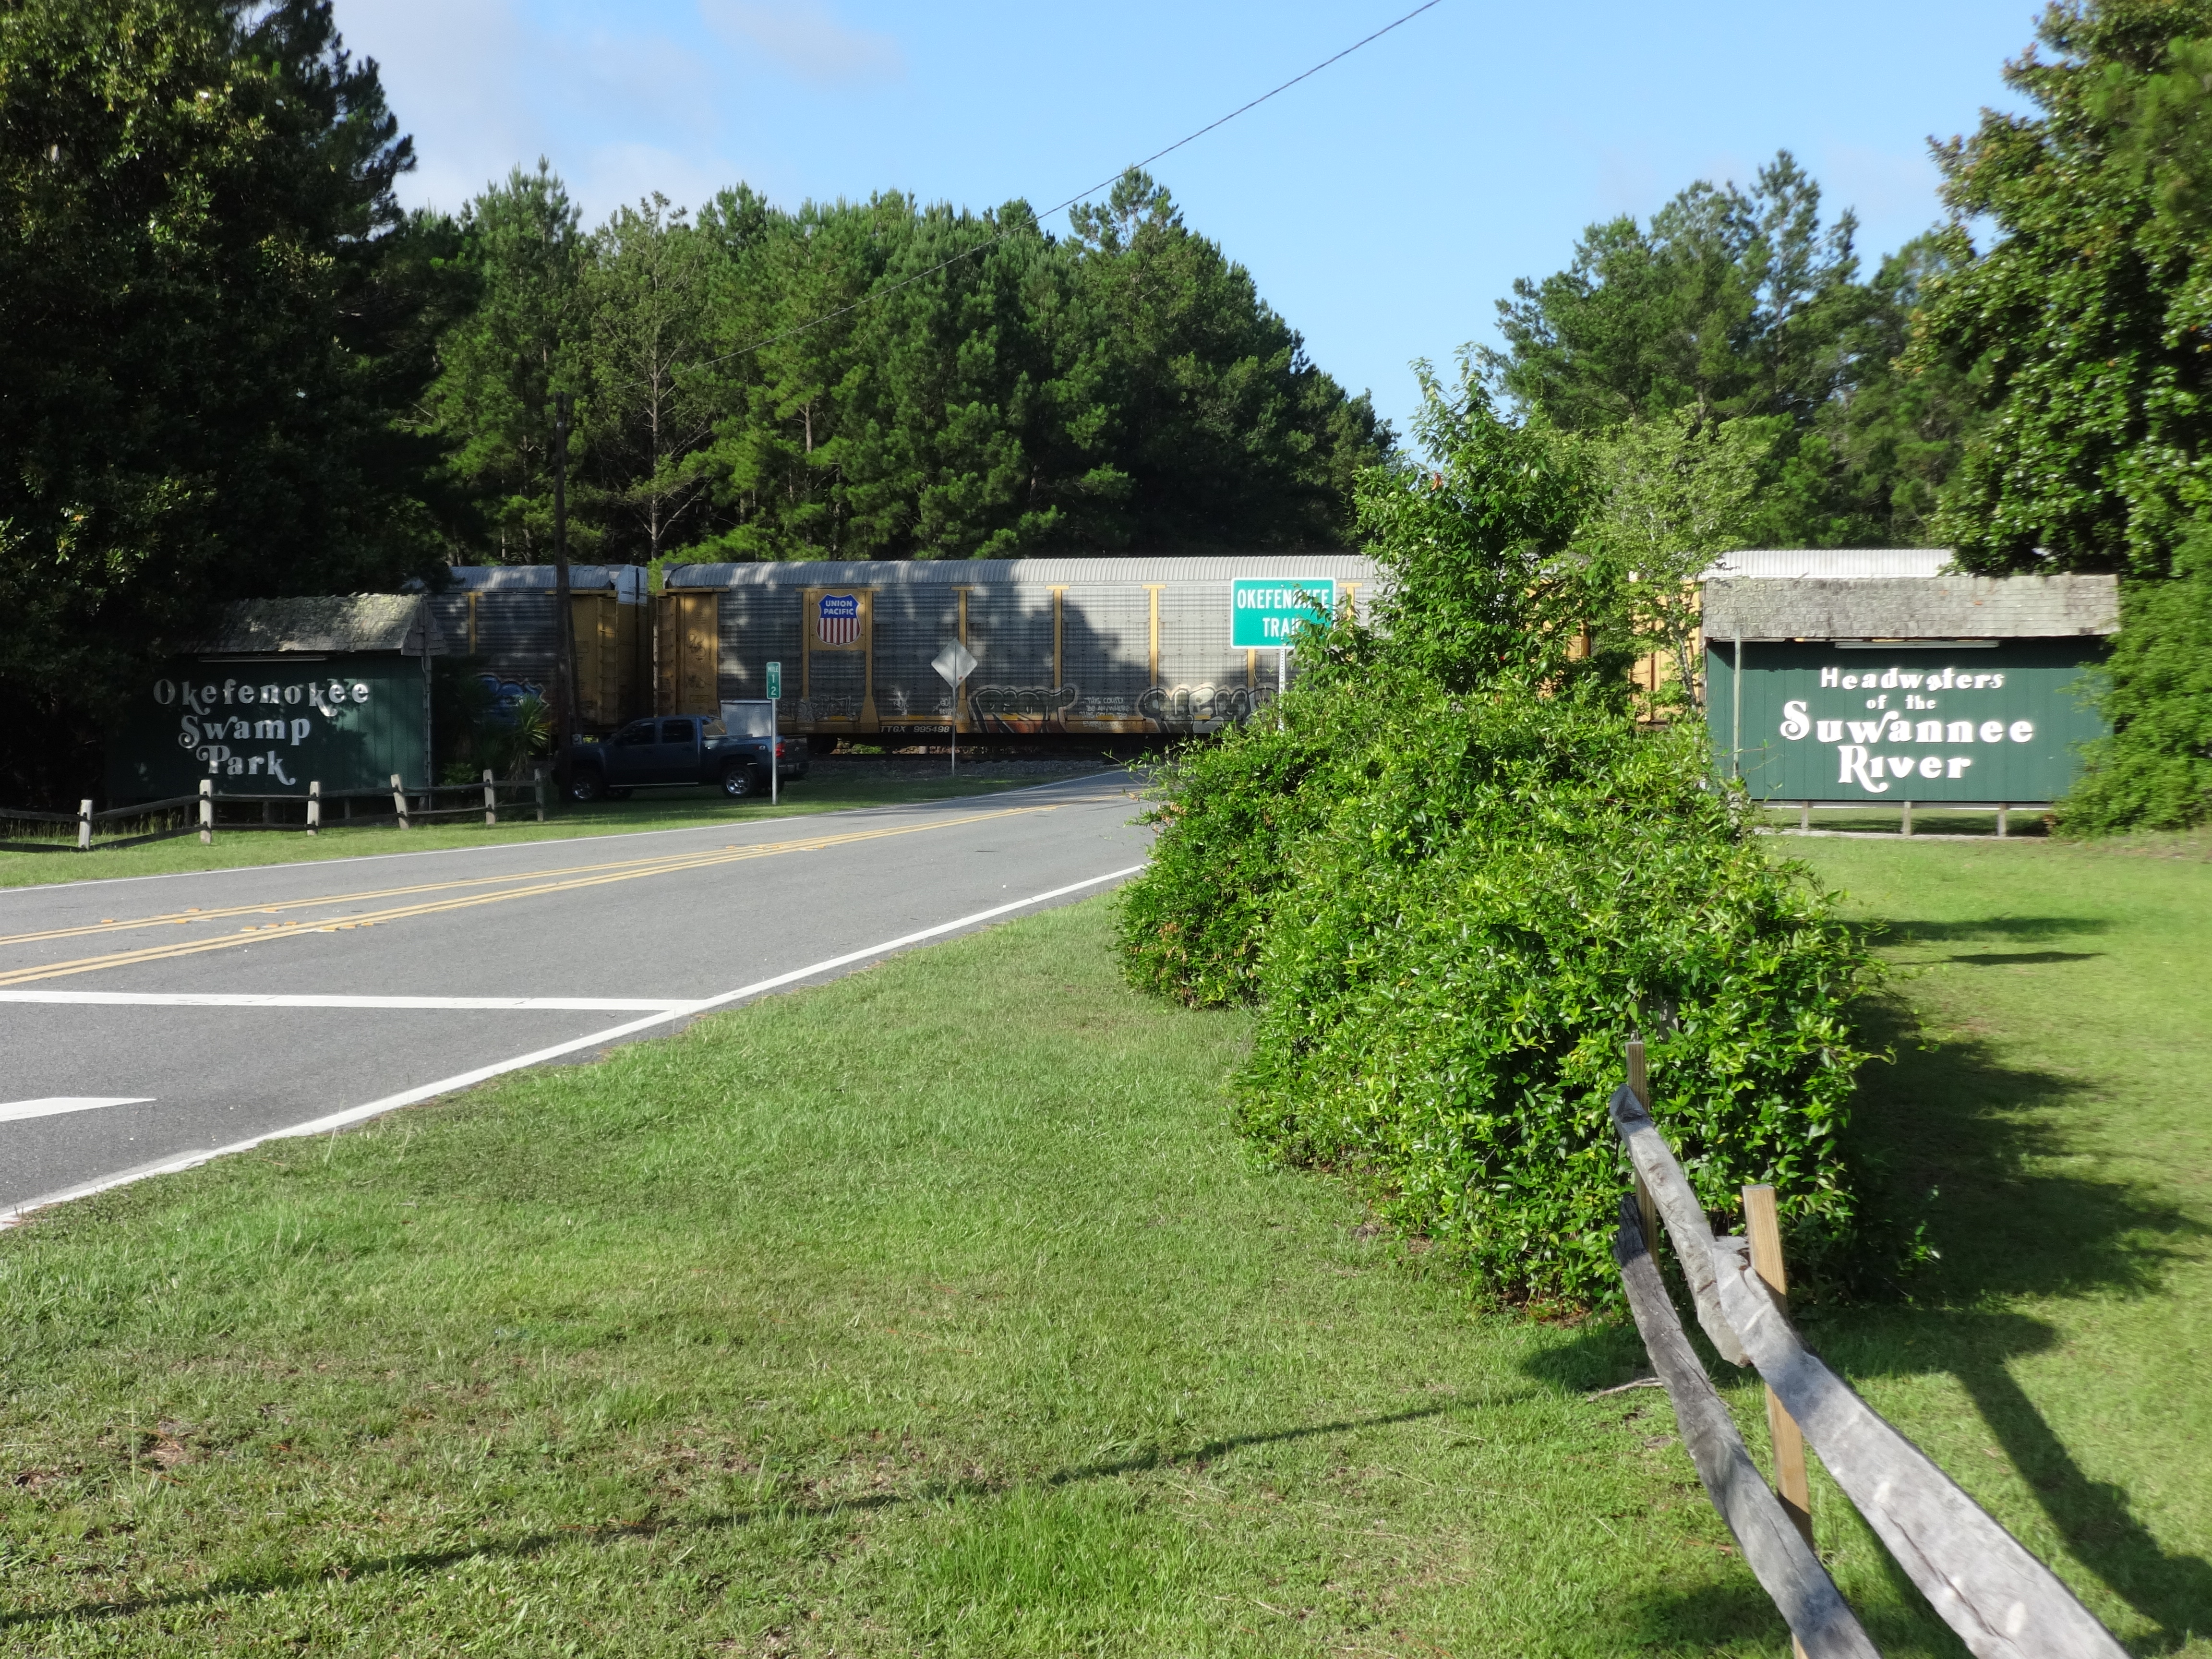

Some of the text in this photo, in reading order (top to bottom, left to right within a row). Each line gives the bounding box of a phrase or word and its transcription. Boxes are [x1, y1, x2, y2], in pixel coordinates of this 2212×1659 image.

[153, 679, 369, 717] Okefenokee
[1820, 667, 2005, 691] Headwaters
[1866, 695, 1936, 709] of the
[179, 715, 310, 749] Swamp
[1780, 701, 2032, 744] Suwannee
[196, 745, 296, 785] Park
[1838, 745, 1972, 793] River
